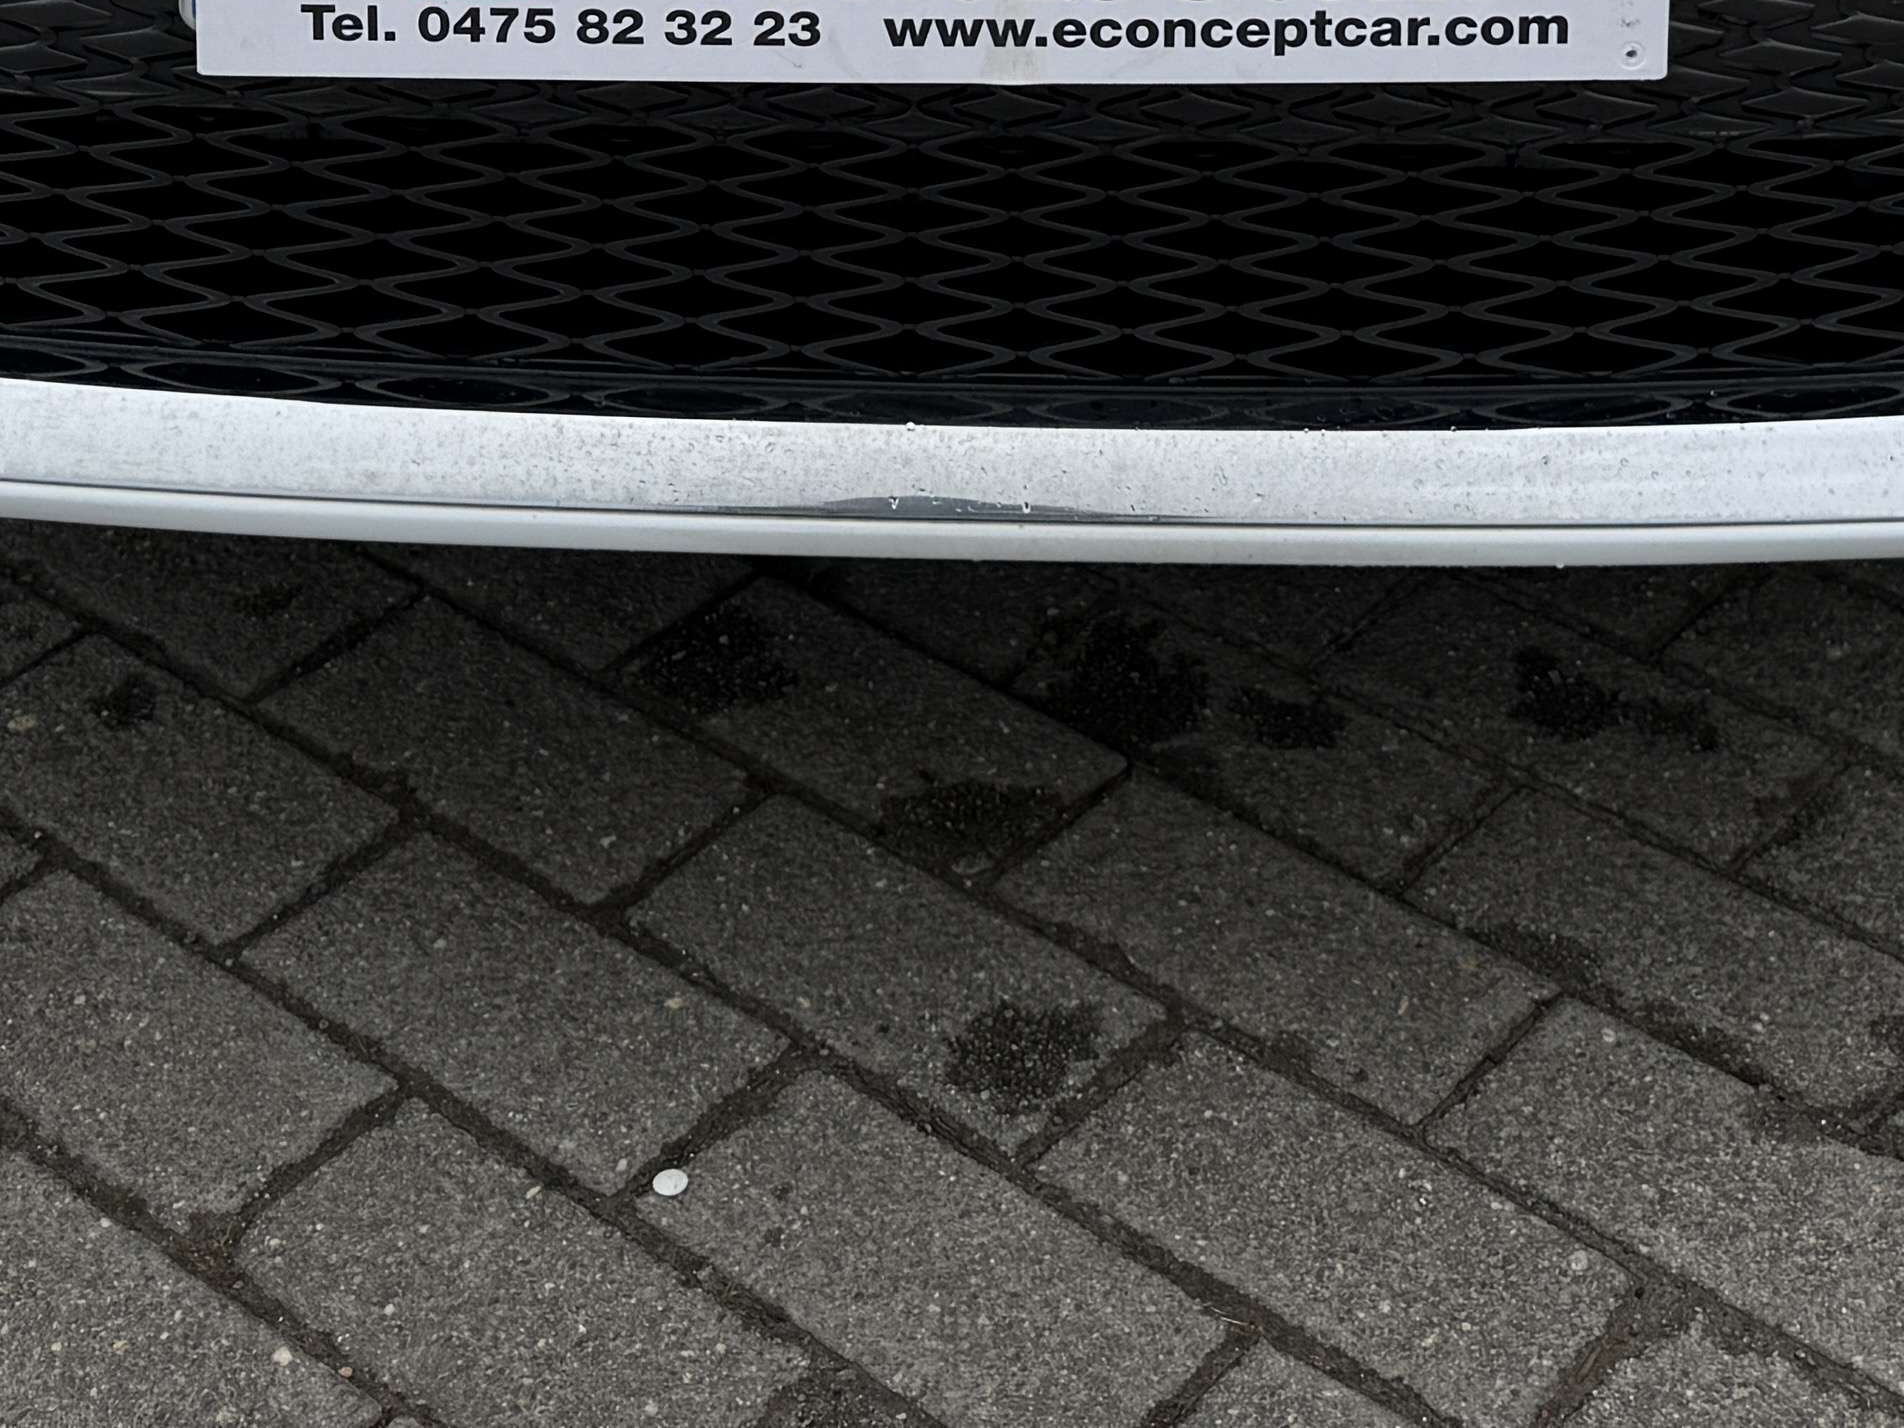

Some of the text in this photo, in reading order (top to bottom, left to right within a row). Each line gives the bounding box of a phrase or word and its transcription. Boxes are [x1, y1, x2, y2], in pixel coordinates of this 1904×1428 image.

[300, 3, 1569, 57] Tel. 0475 82 32 23 www.econceptcar.com
